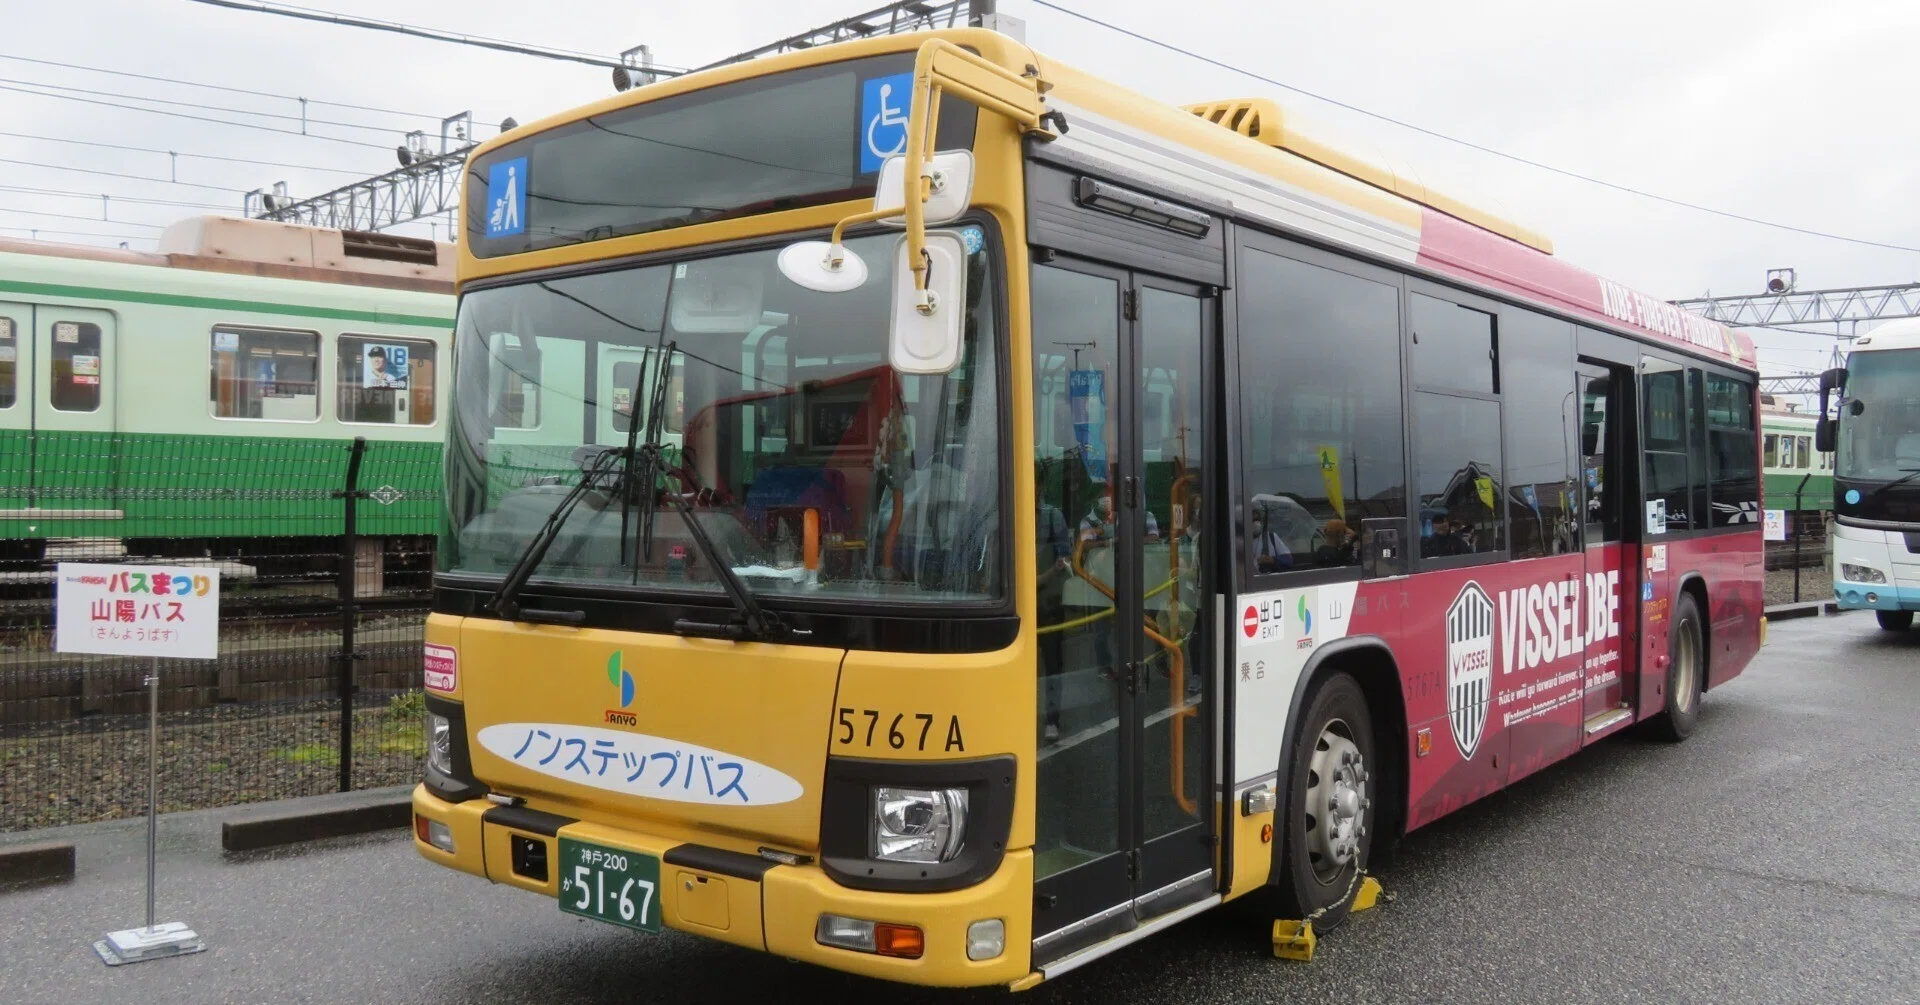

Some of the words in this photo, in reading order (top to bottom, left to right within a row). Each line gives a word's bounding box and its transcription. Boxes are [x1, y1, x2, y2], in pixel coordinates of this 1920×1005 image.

[1598, 278, 1635, 324] KOBE
[386, 347, 406, 366] 18
[109, 571, 211, 597] バスまつり
[91, 598, 185, 623] 山陽バス
[1259, 599, 1283, 623] 出口
[1499, 577, 1584, 675] VISSEL
[1585, 570, 1619, 647] OBE
[1262, 624, 1280, 639] EXIT
[1296, 638, 1313, 650] SANYO
[1240, 659, 1265, 683] 乗合
[1461, 649, 1489, 673] VISSEL
[604, 709, 637, 727] SANYO
[839, 707, 965, 752] 5767A
[513, 729, 749, 802] ノンステップバス
[575, 865, 655, 925] 51-67
